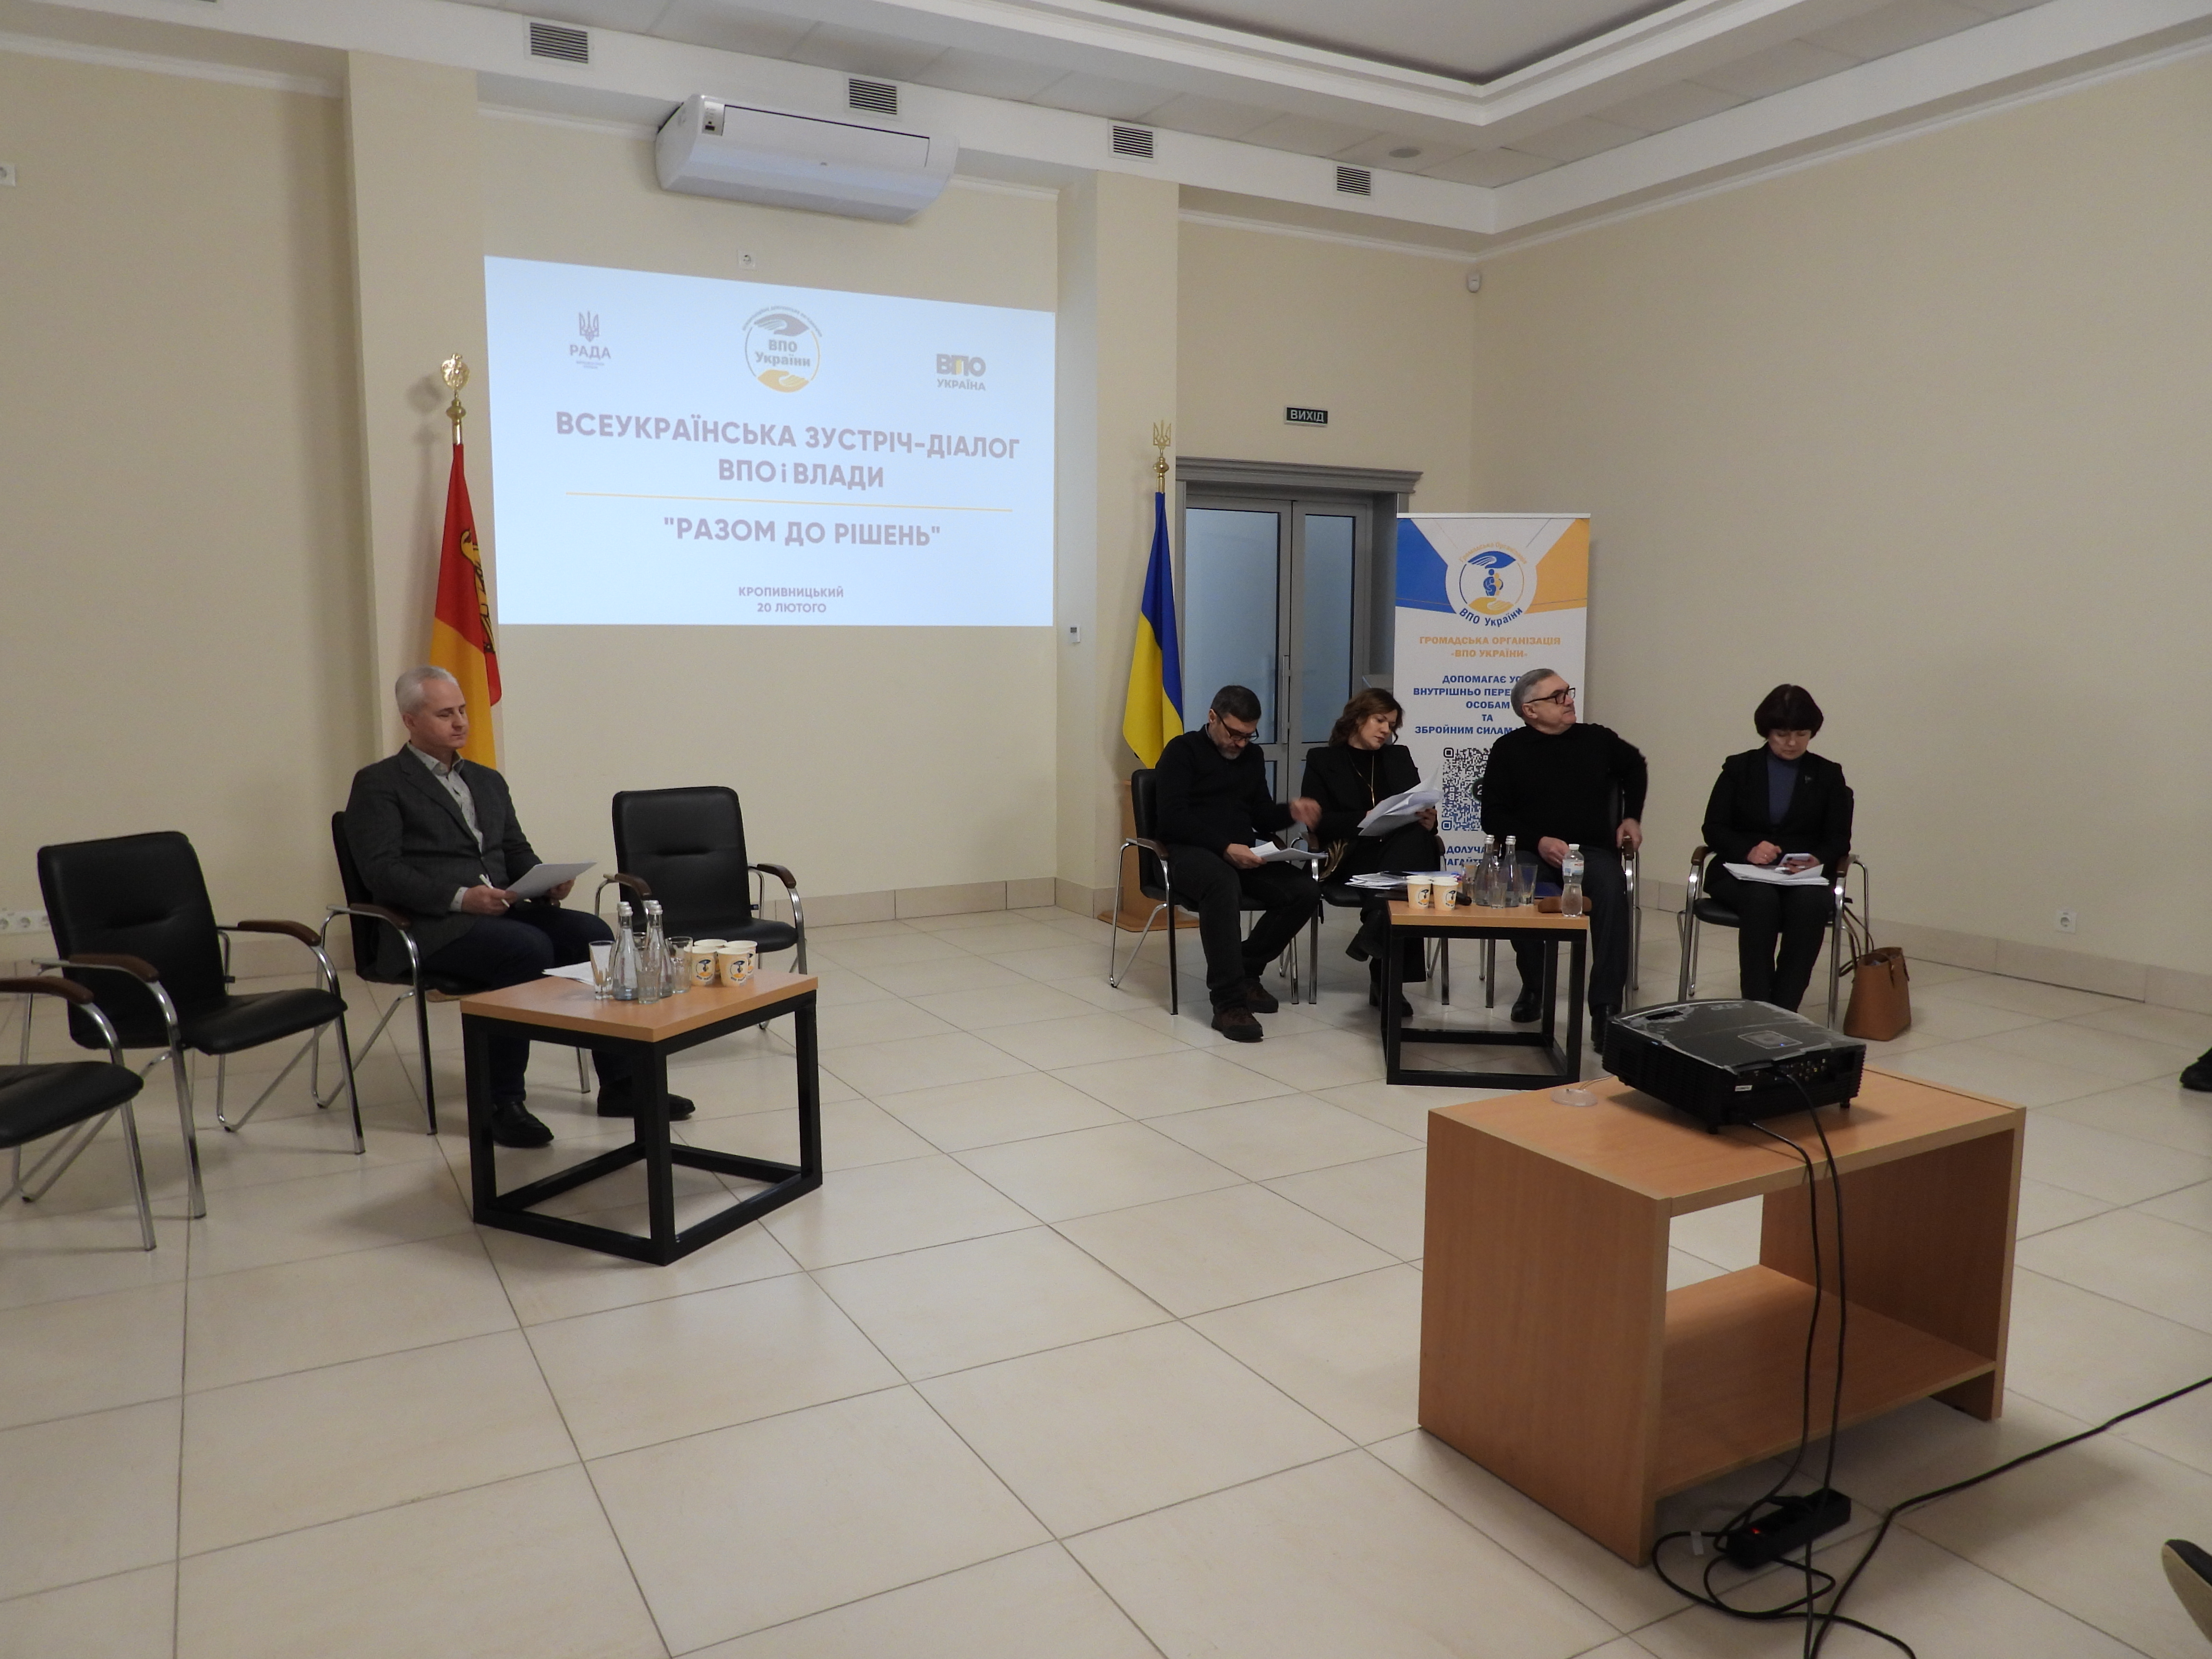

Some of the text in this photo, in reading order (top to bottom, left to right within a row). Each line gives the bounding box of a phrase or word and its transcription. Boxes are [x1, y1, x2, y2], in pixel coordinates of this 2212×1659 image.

[570, 344, 611, 360] РАДА
[769, 339, 797, 352] ВПО
[755, 351, 810, 367] України
[937, 354, 986, 377] ВПО
[937, 378, 986, 391] УКРАЇНА
[1290, 409, 1324, 422] ВИХІД
[556, 411, 1020, 459] ВСЕУКРАЇНСЬКА ЗУСТРІЧ-ДІАЛОГ
[719, 458, 776, 482] ВПО
[793, 462, 884, 490] ВЛАДИ
[664, 517, 940, 546] "РАЗОМ ДО РІШЕНЬ"
[739, 586, 843, 599] КРОПИВНИЦЬКИЙ
[757, 602, 827, 613] 20 ЛЮТОГО
[1459, 608, 1523, 627] ВПО України
[1419, 637, 1561, 645] ГРОМАДСЬКА ОРГАНІЗАЦІЯ
[1443, 675, 1506, 684] ДОПОМАГАЄ
[1415, 724, 1473, 734] ЗБРОЙНИМ
